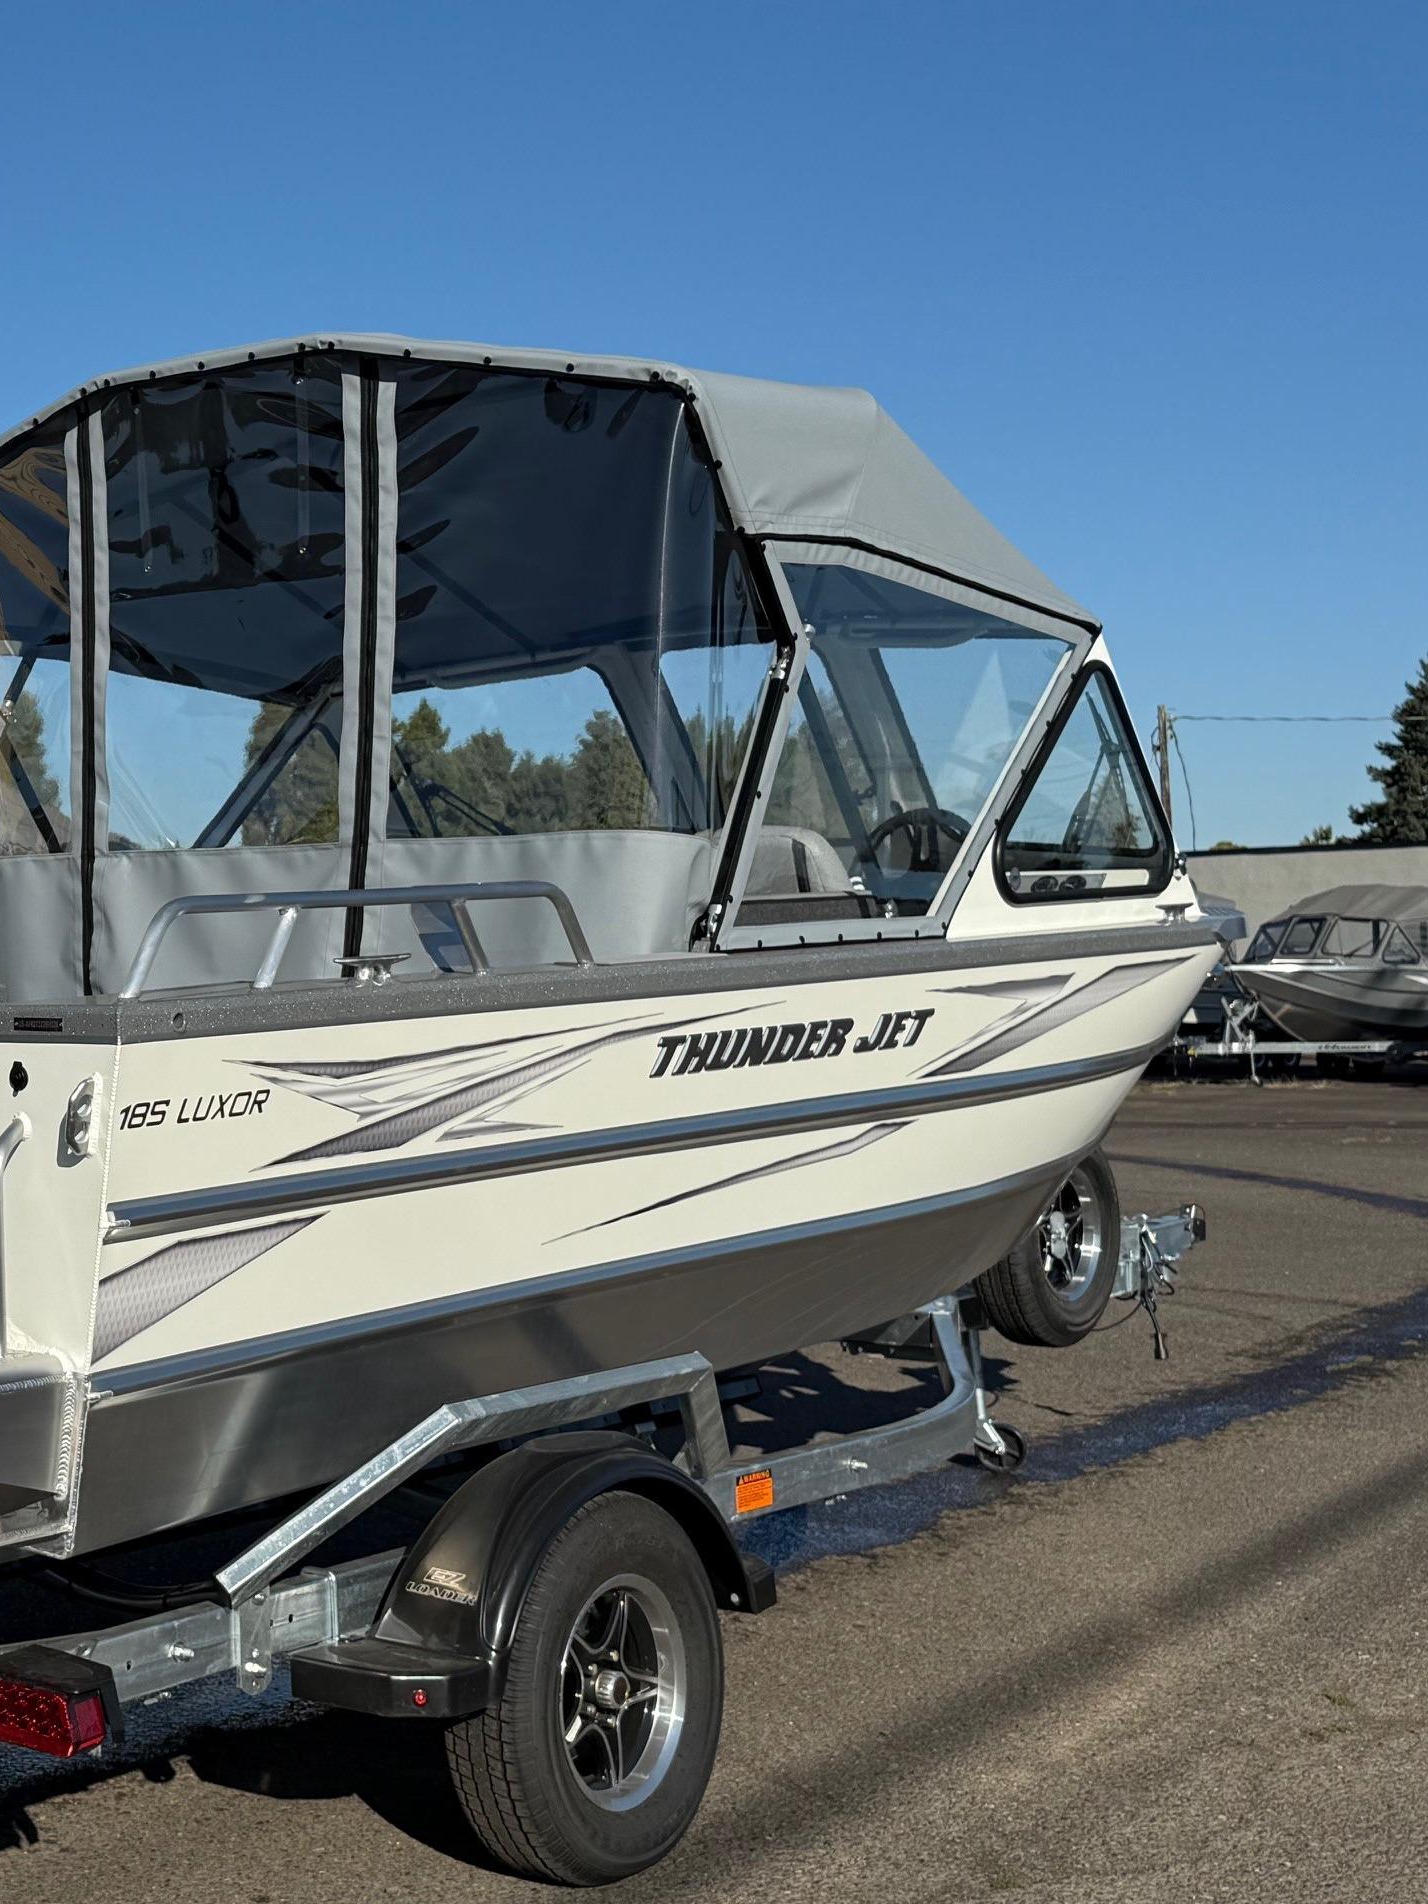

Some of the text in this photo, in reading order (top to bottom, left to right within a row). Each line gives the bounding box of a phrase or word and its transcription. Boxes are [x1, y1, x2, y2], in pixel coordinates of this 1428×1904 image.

[649, 1008, 936, 1079] THUNDER JET
[119, 1088, 271, 1130] 185 LUXOR
[405, 1581, 477, 1606] LOADER
[423, 1566, 466, 1588] EZ
